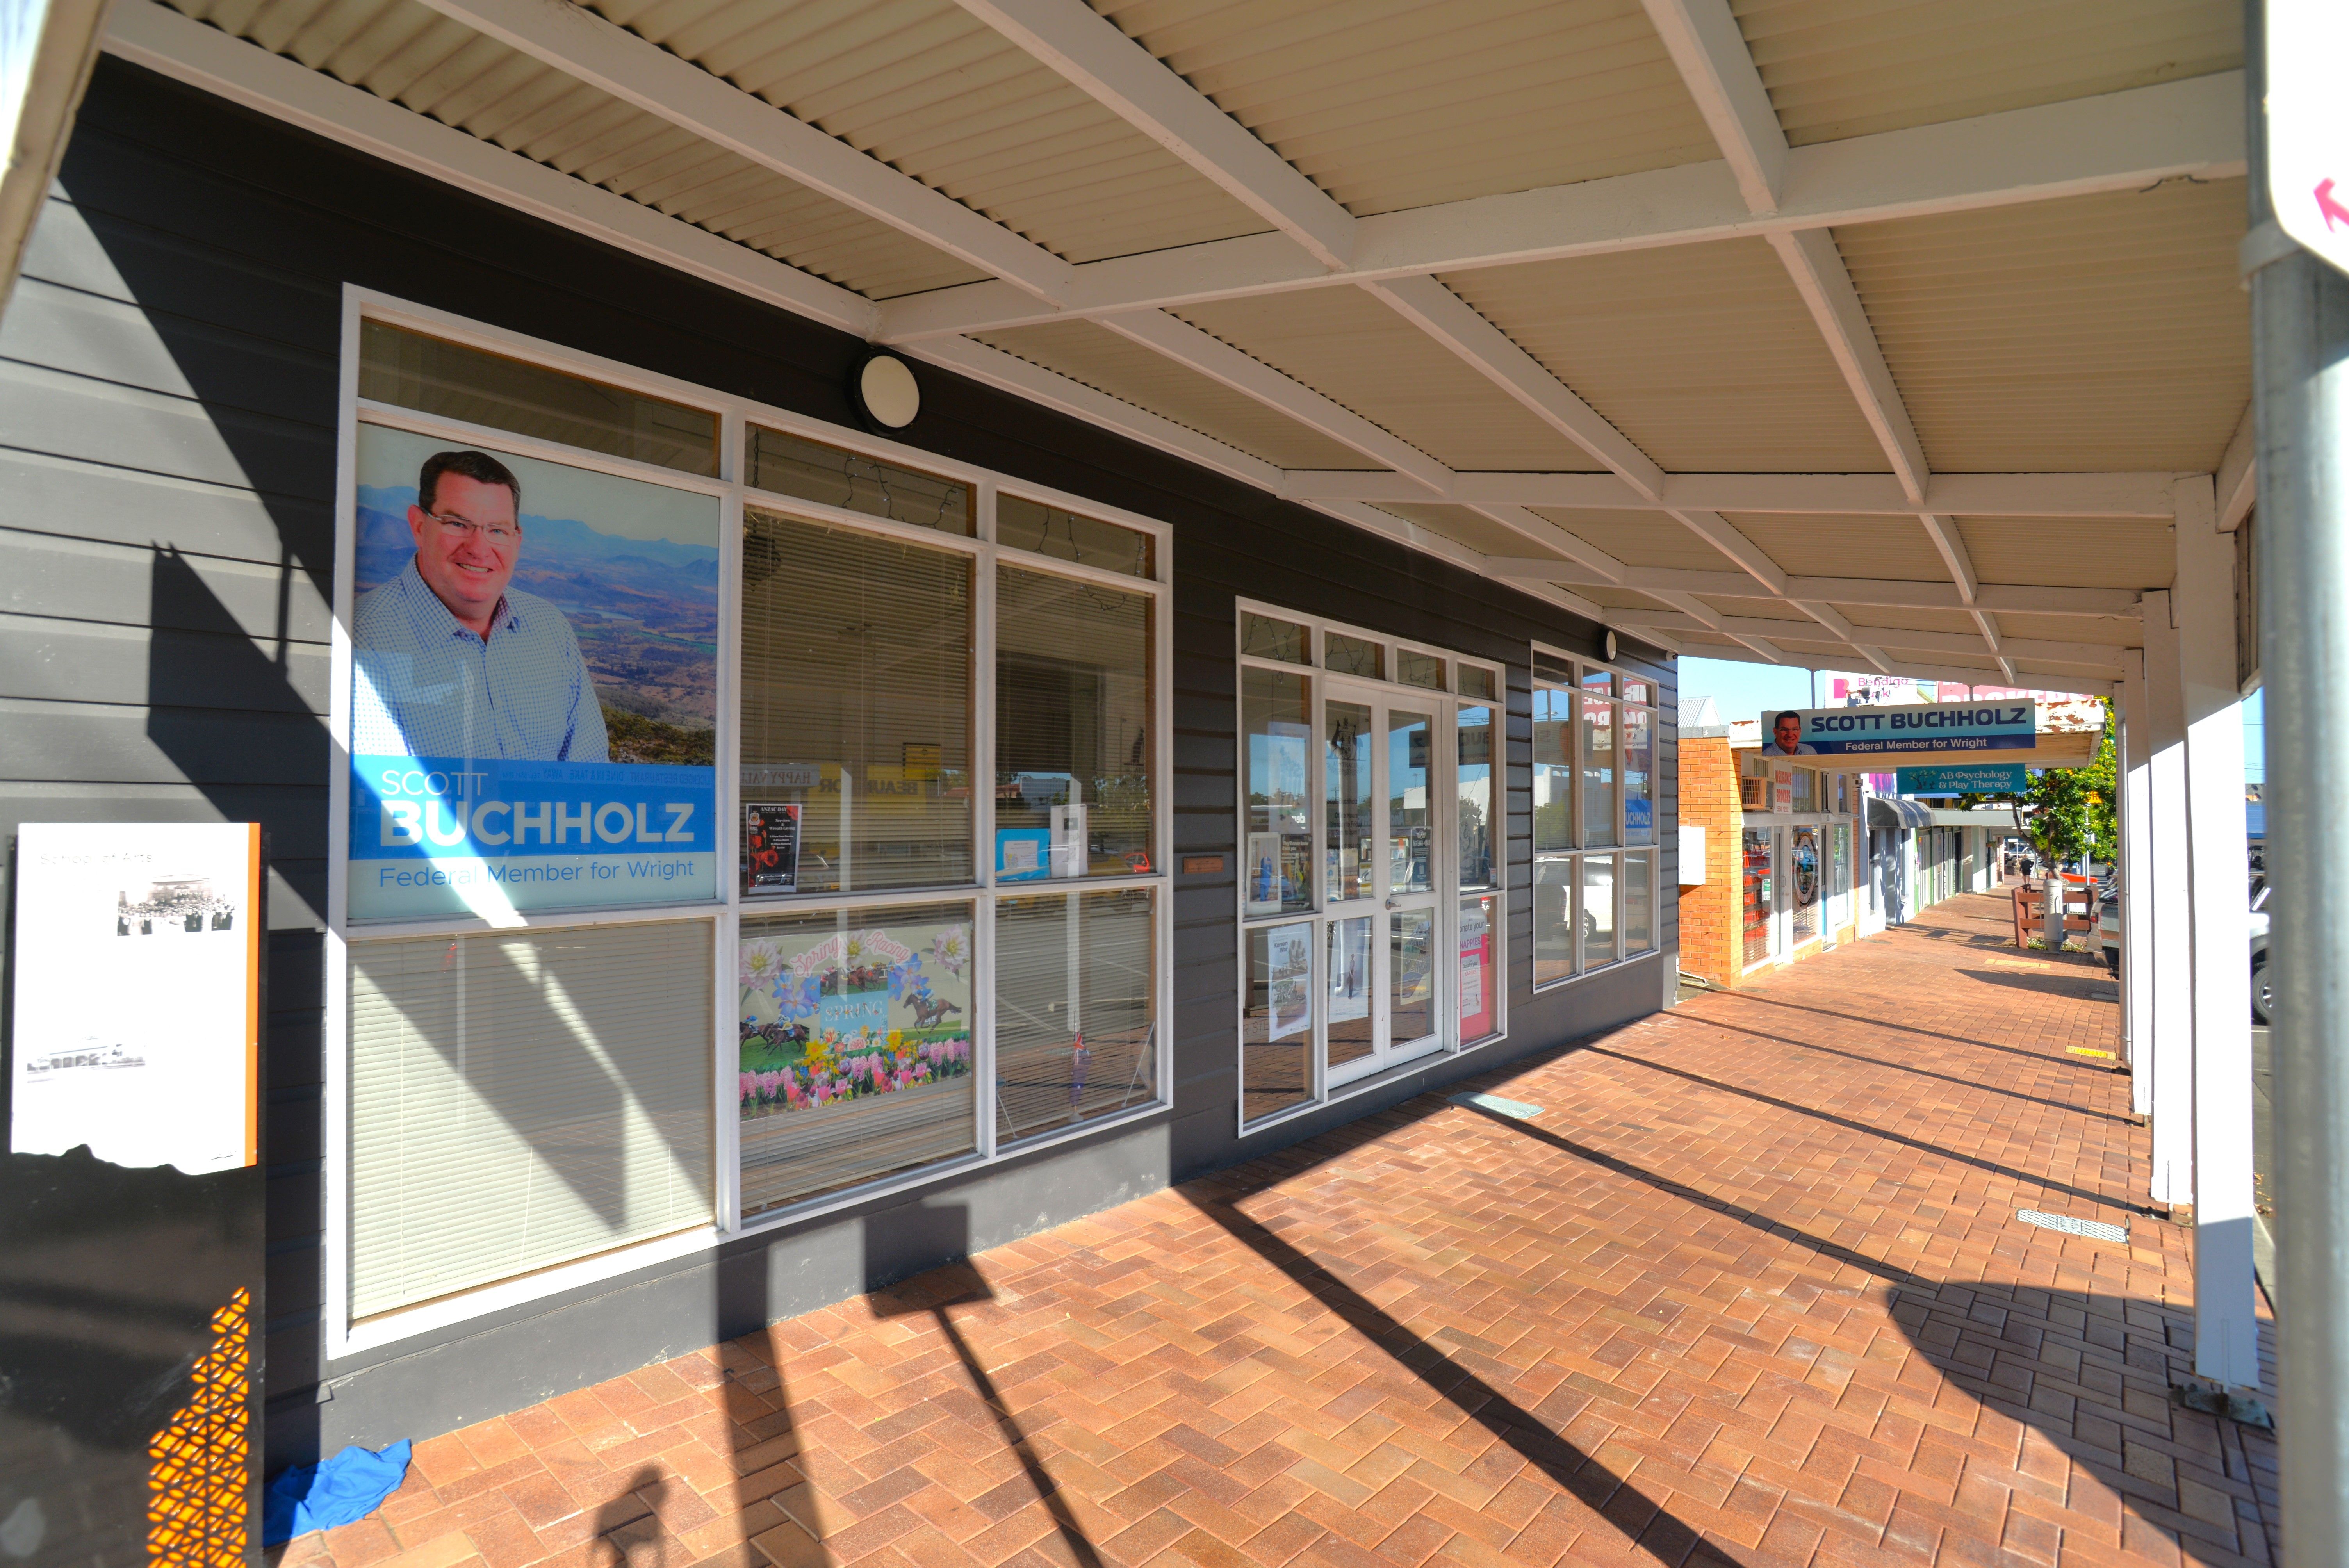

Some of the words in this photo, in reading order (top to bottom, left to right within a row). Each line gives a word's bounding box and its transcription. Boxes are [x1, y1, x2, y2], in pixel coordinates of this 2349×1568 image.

[1811, 714, 1885, 732] SCOTT
[1891, 707, 2026, 729] BUCHHOLZ
[1846, 741, 1883, 751] Federal
[1886, 739, 1930, 750] Member
[1932, 739, 1948, 748] for
[1950, 738, 1987, 749] Wright
[381, 770, 488, 796] SCOTT
[1775, 770, 1792, 786] INSURANCE
[1955, 770, 2012, 780] Psychology
[1949, 781, 1969, 790] Play
[1971, 780, 2012, 789] Therapy
[1777, 789, 1791, 804] BROKERS
[381, 800, 694, 846] BUCHHOLZ
[380, 866, 477, 887] Federal
[488, 863, 583, 883] Member
[591, 861, 620, 879] for
[627, 859, 694, 880] Wright
[1473, 921, 1485, 932] your
[1460, 936, 1481, 949] NAPPIES
[791, 936, 841, 976] Spring
[866, 932, 909, 964] Racing
[825, 1000, 883, 1021] SPRING
